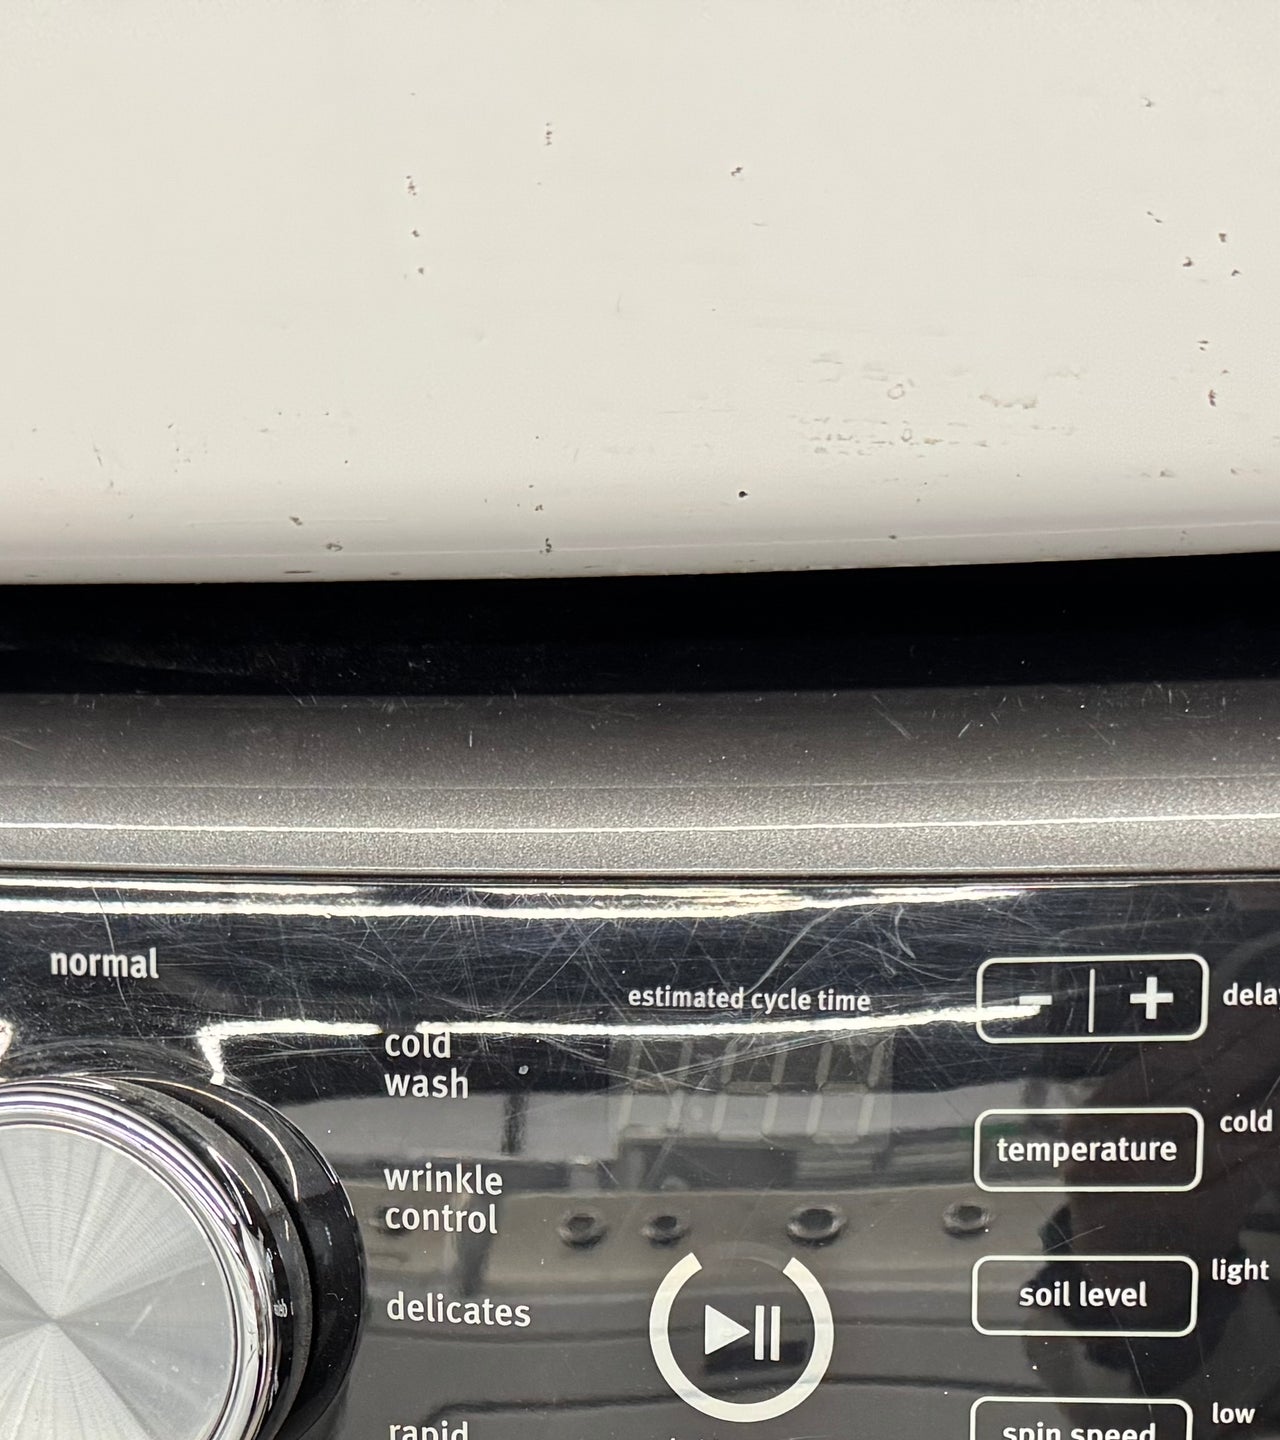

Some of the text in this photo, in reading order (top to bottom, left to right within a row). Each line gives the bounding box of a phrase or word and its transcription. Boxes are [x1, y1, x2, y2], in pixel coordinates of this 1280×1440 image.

[50, 947, 160, 979] normal
[628, 985, 871, 1015] estimated cycle time
[385, 1029, 450, 1058] cold
[384, 1067, 469, 1100] wash
[1219, 1108, 1273, 1133] cold
[996, 1137, 1177, 1168] temperature
[383, 1161, 503, 1196] wrinkle
[385, 1203, 498, 1234] control
[1211, 1257, 1270, 1286] light
[386, 1290, 531, 1327] delicates
[1019, 1280, 1147, 1307] soil level
[1212, 1401, 1256, 1424] low
